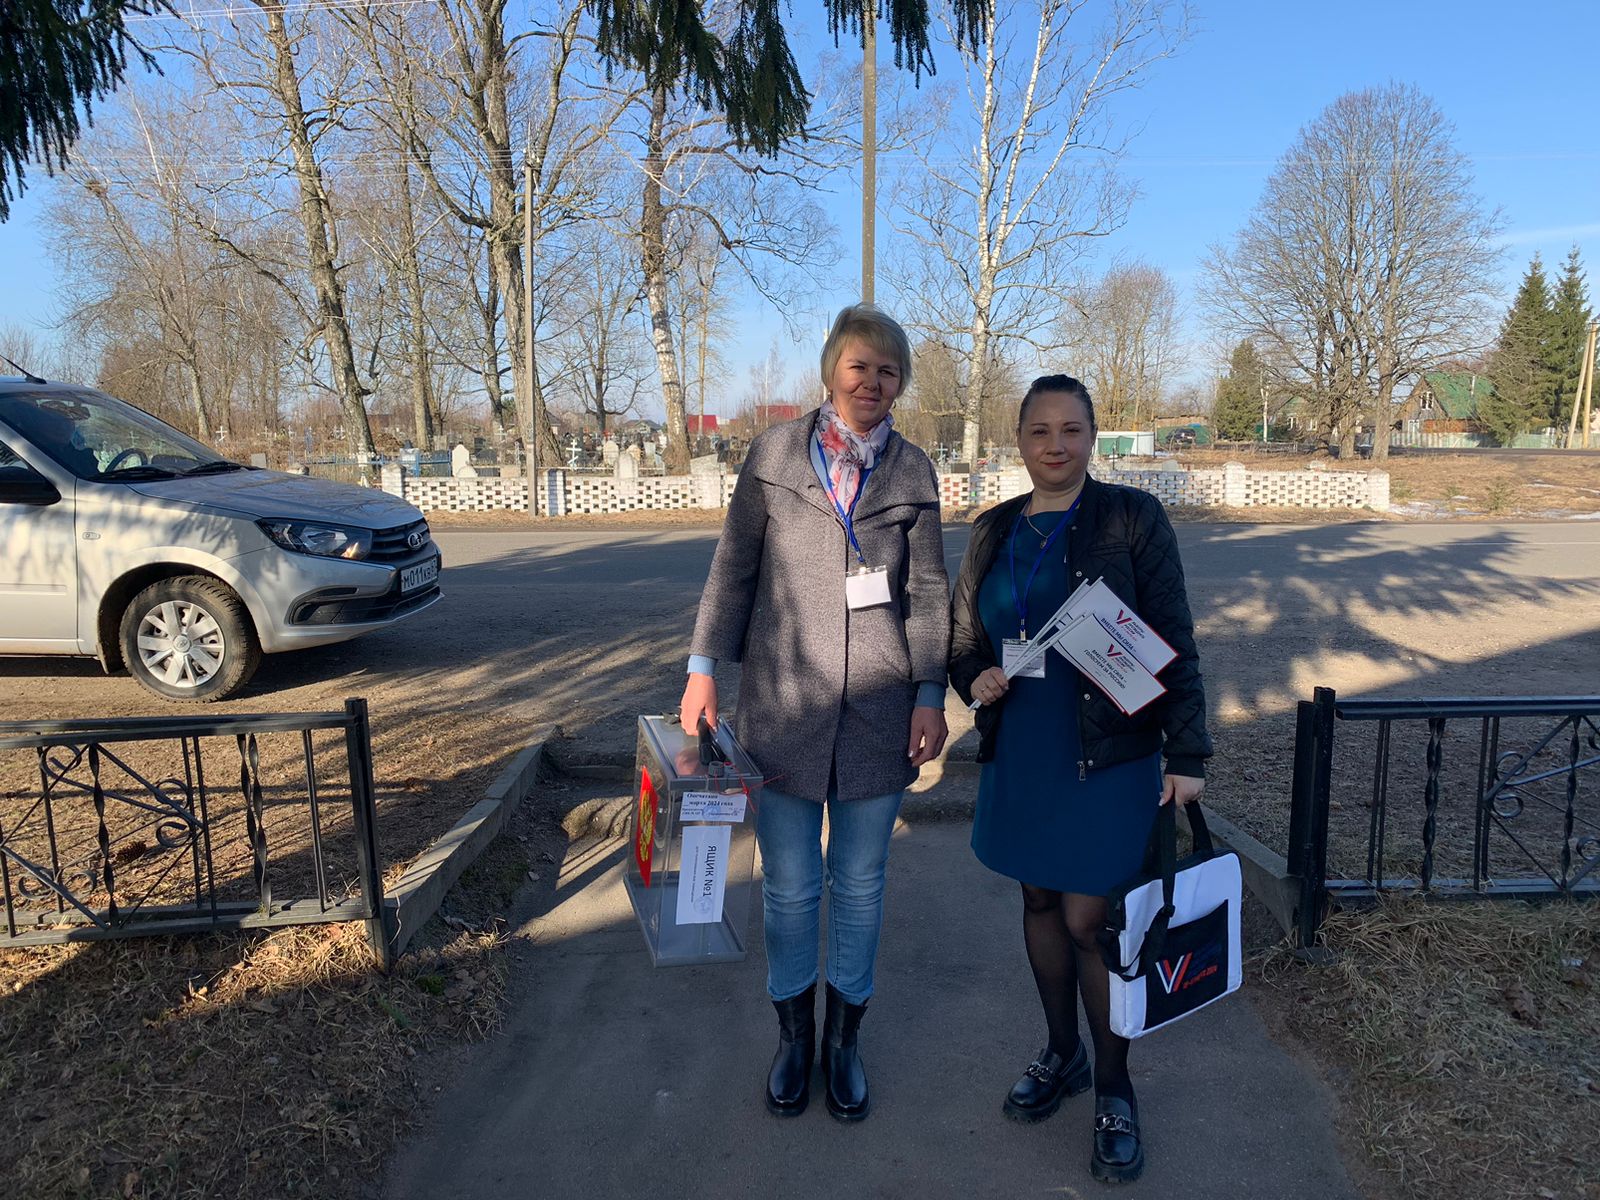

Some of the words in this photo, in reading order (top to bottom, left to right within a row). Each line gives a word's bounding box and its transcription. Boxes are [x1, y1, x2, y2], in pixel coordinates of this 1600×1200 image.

[1100, 618, 1117, 633] ВМЕСТЕ
[1115, 631, 1124, 640] МЫ
[1122, 639, 1134, 650] СИЛА
[1084, 649, 1104, 669] ГОЛОСУЕМ
[1091, 649, 1107, 664] ВМЕСТЕ
[1106, 662, 1114, 671] МЫ
[1112, 669, 1124, 681] СИЛА
[705, 845, 717, 877] ЯЩИК
[703, 879, 713, 897] №1
